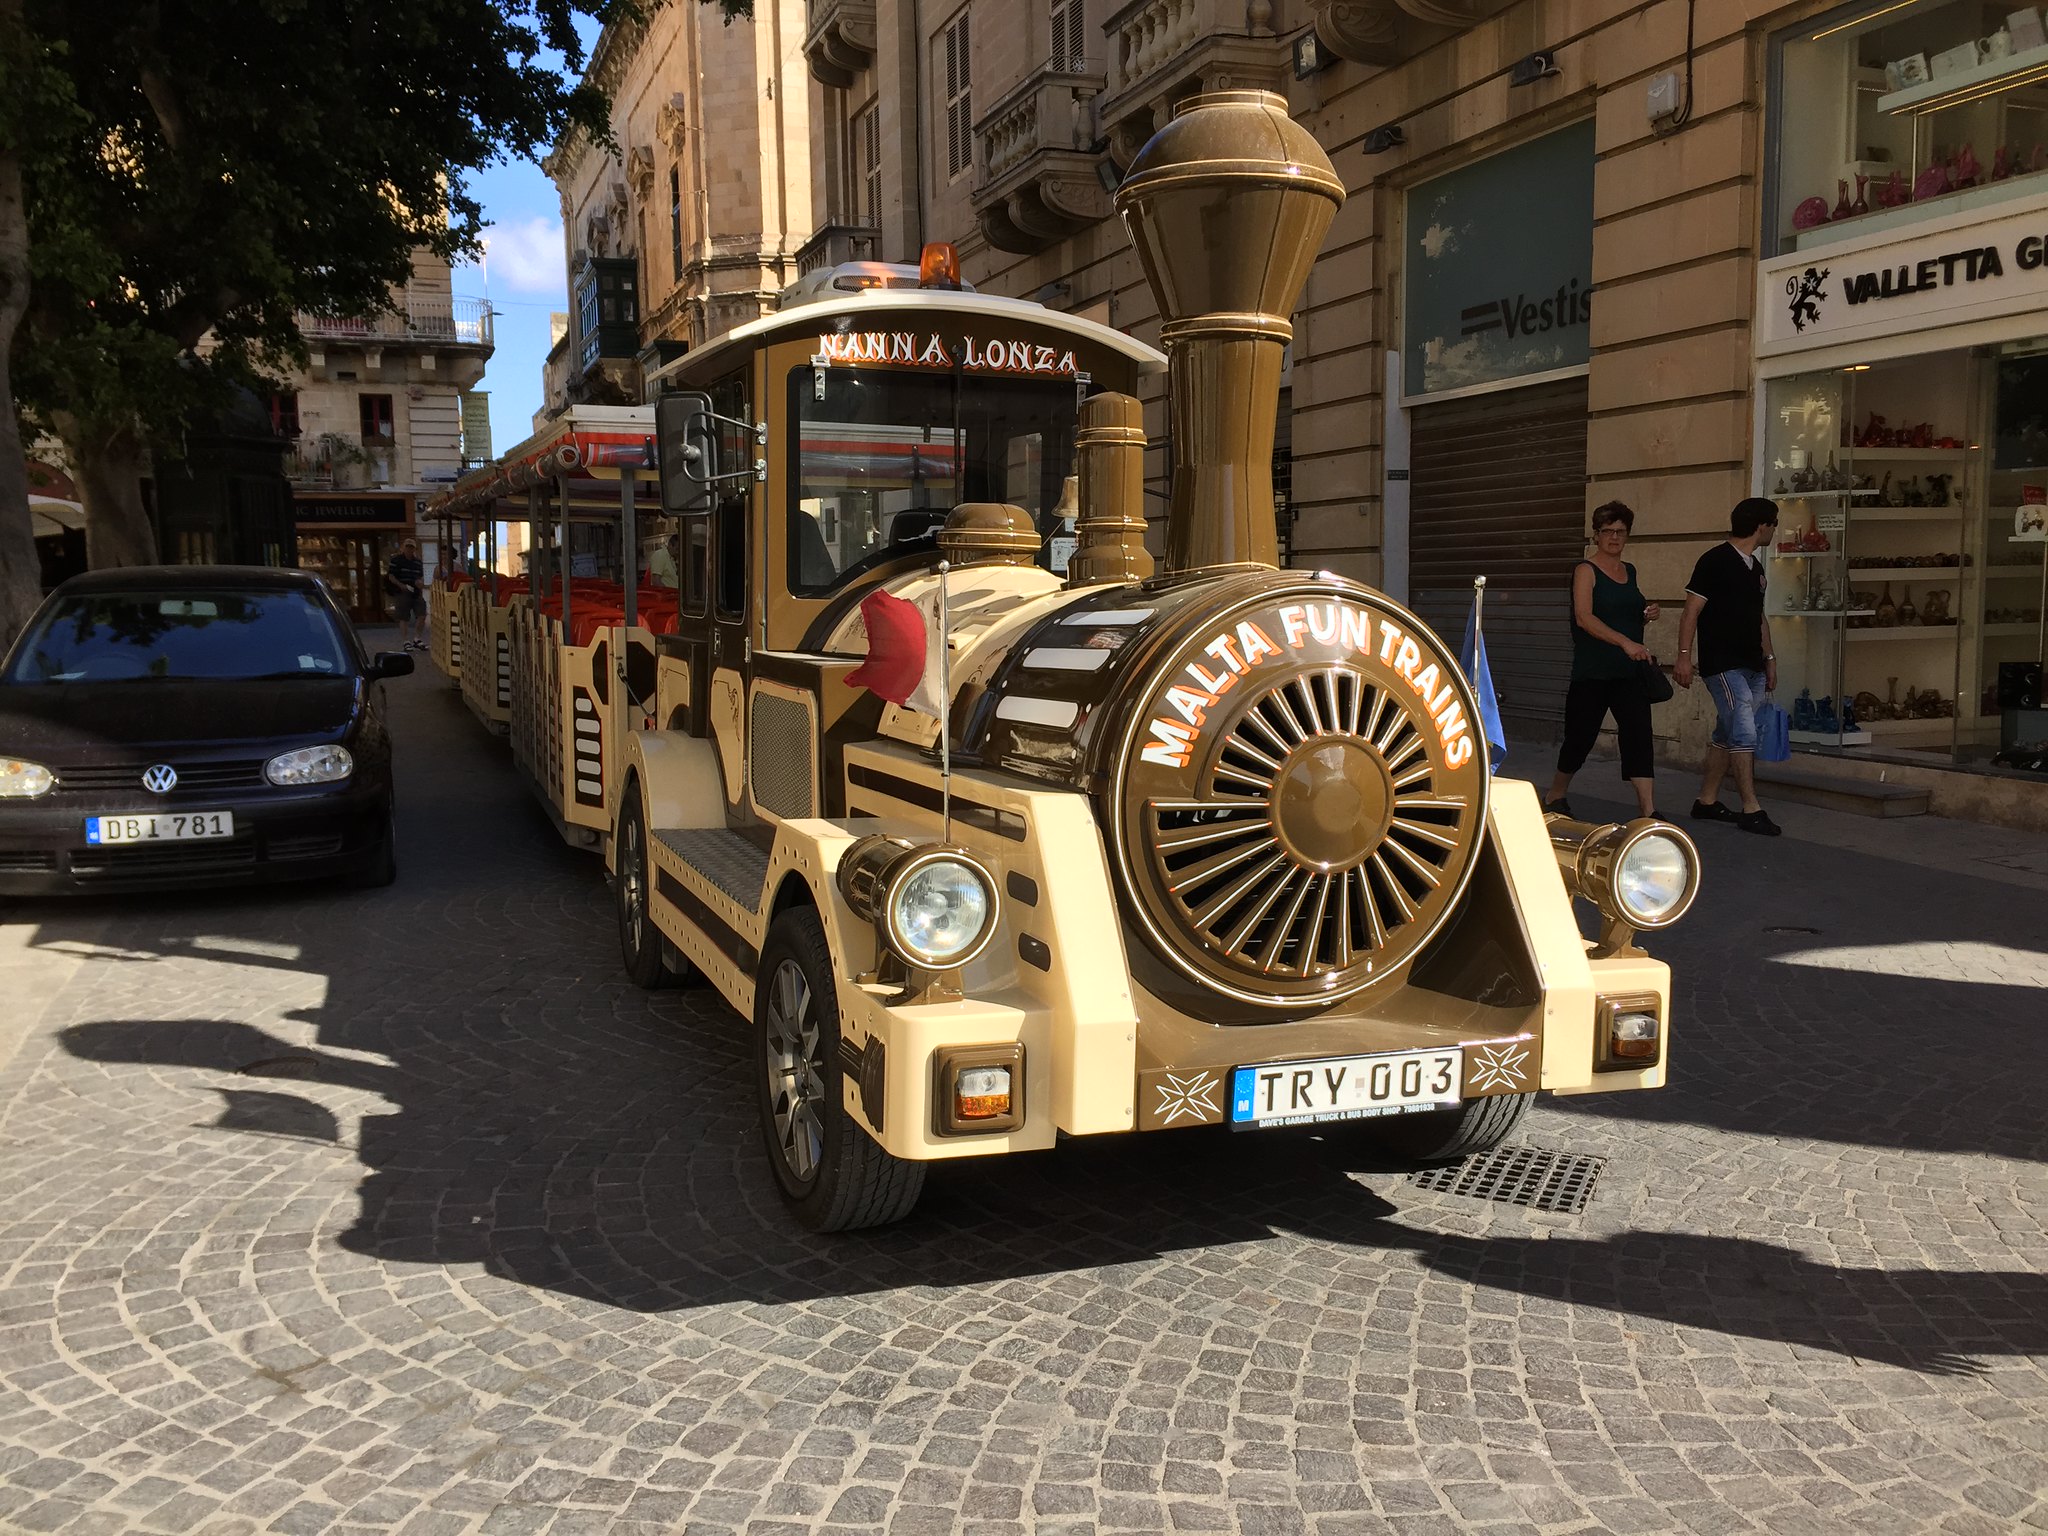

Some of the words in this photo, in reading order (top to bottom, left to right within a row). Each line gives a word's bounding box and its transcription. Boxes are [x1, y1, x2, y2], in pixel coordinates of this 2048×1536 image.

[1842, 246, 2004, 305] VALLETTA
[818, 331, 952, 366] NANNA
[962, 335, 1080, 375] LONZA
[315, 506, 376, 517] JEWELLERS
[1140, 620, 1284, 768] MALTA
[1278, 603, 1372, 656] FUN
[1379, 619, 1474, 771] TRAINS
[172, 815, 224, 837] 781
[1260, 1066, 1347, 1111] TRY
[1369, 1057, 1453, 1101] 003
[1237, 1099, 1250, 1113] M
[1259, 1118, 1284, 1128] DAVE'S
[1284, 1114, 1314, 1126] GARAGE
[1315, 1111, 1339, 1122] TRUCK
[1340, 1111, 1346, 1120] &
[1347, 1109, 1361, 1119] BUS
[1362, 1108, 1381, 1118] BODY
[1382, 1106, 1401, 1116] SHOP
